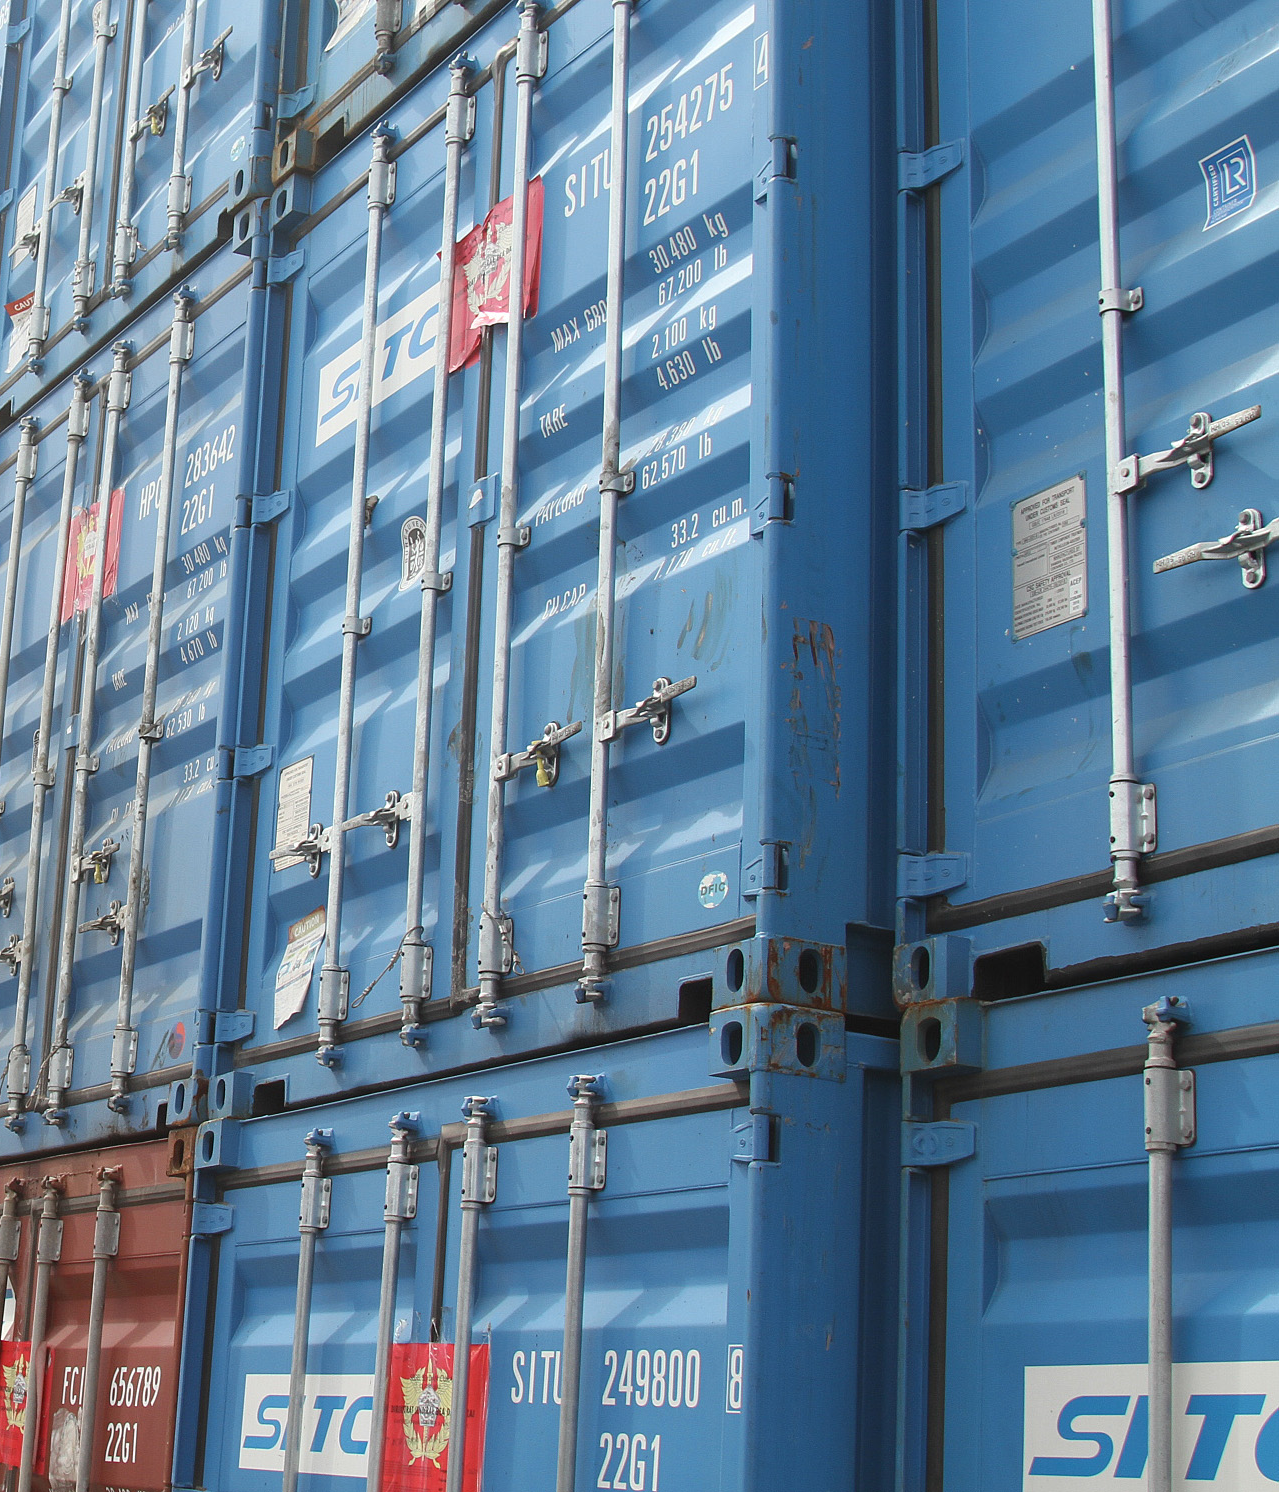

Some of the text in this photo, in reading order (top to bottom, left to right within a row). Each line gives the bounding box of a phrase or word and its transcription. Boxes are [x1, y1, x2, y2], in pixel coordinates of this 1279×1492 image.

[645, 62, 733, 162] 254275
[756, 35, 768, 80] 4
[643, 149, 699, 227] 22G1
[1208, 165, 1219, 207] CERTIFIED
[1223, 157, 1247, 194] LR
[550, 211, 729, 353] MAX GRO 30.480 kg
[658, 244, 727, 305] 67.200 lb
[14, 295, 35, 312] CAUT
[539, 304, 717, 438] TARE 2.100 kg
[656, 336, 722, 390] 4.630 lb
[138, 424, 236, 520] HPC 283642
[534, 484, 588, 526] PAYLOAD
[704, 404, 725, 426] kg
[641, 432, 712, 490] 62.570 lb
[180, 483, 215, 535] 22G1
[1052, 486, 1075, 501] TRANSPORT
[213, 536, 228, 555] kg
[670, 512, 699, 548] 33.2
[219, 560, 227, 578] lb
[205, 606, 215, 626] kg
[206, 630, 218, 649] lb
[198, 702, 206, 721] lb
[183, 759, 200, 783] 33.2
[700, 881, 726, 896] DFIC
[294, 914, 320, 937] CAUTION
[109, 1365, 161, 1408] 656789
[511, 1348, 743, 1409] SITU 249800 8
[104, 1422, 138, 1464] 22G1
[1028, 1393, 1279, 1482] SIT
[597, 1432, 661, 1492] 22G1
